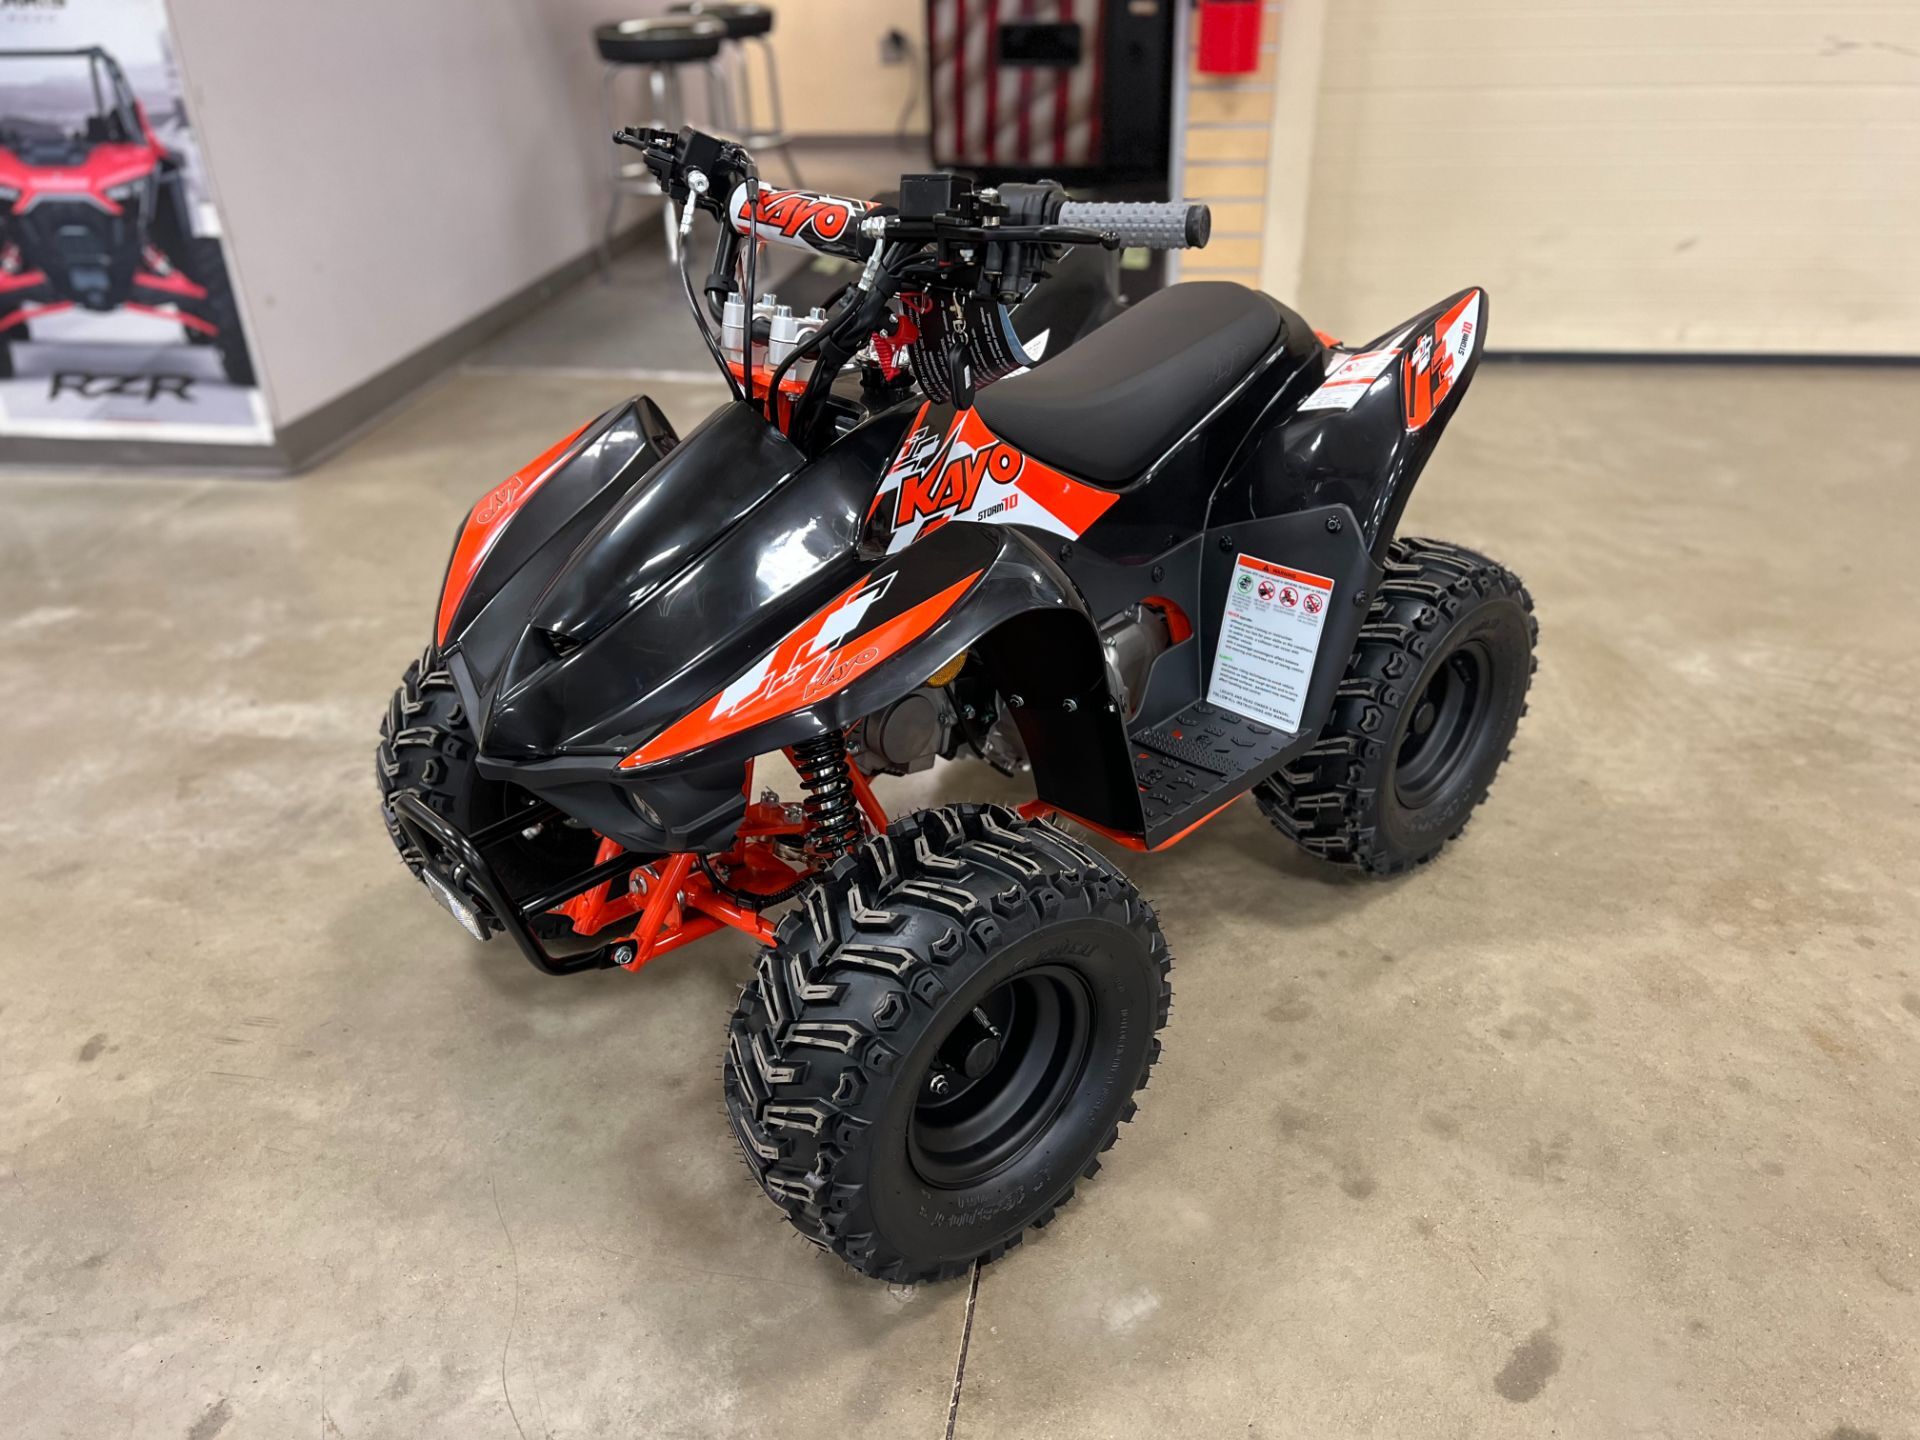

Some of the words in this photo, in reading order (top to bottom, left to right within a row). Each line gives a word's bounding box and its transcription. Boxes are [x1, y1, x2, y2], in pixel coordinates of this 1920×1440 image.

[738, 187, 850, 242] KAYO
[49, 369, 197, 404] RZR
[895, 442, 1024, 529] KAYO
[1272, 568, 1297, 578] WARNING
[803, 647, 879, 701] KAYO
